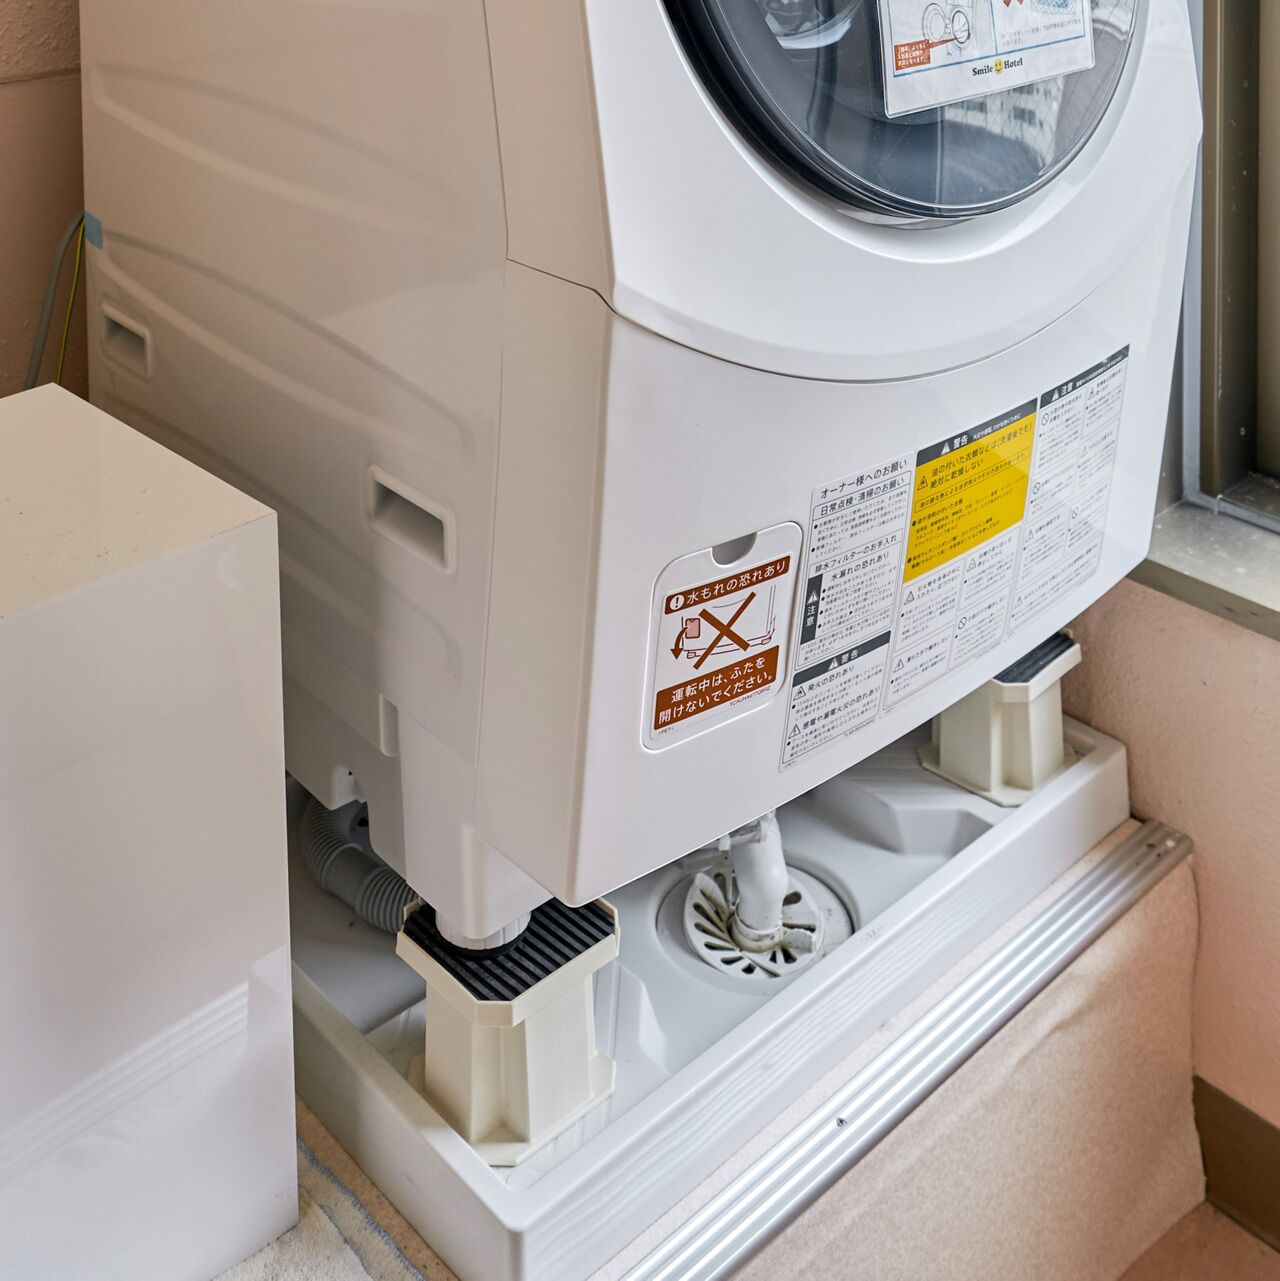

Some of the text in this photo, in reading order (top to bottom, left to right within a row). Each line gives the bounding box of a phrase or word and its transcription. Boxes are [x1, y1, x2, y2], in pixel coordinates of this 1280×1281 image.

[972, 58, 1023, 76] Smile Hotel
[954, 435, 968, 449] 警告
[821, 459, 907, 499] オーナー様へのお願い
[687, 560, 786, 605] 水もれの恐れあり
[659, 672, 772, 724] 開けないでください。
[672, 657, 765, 703] 運転中は、ふたを
